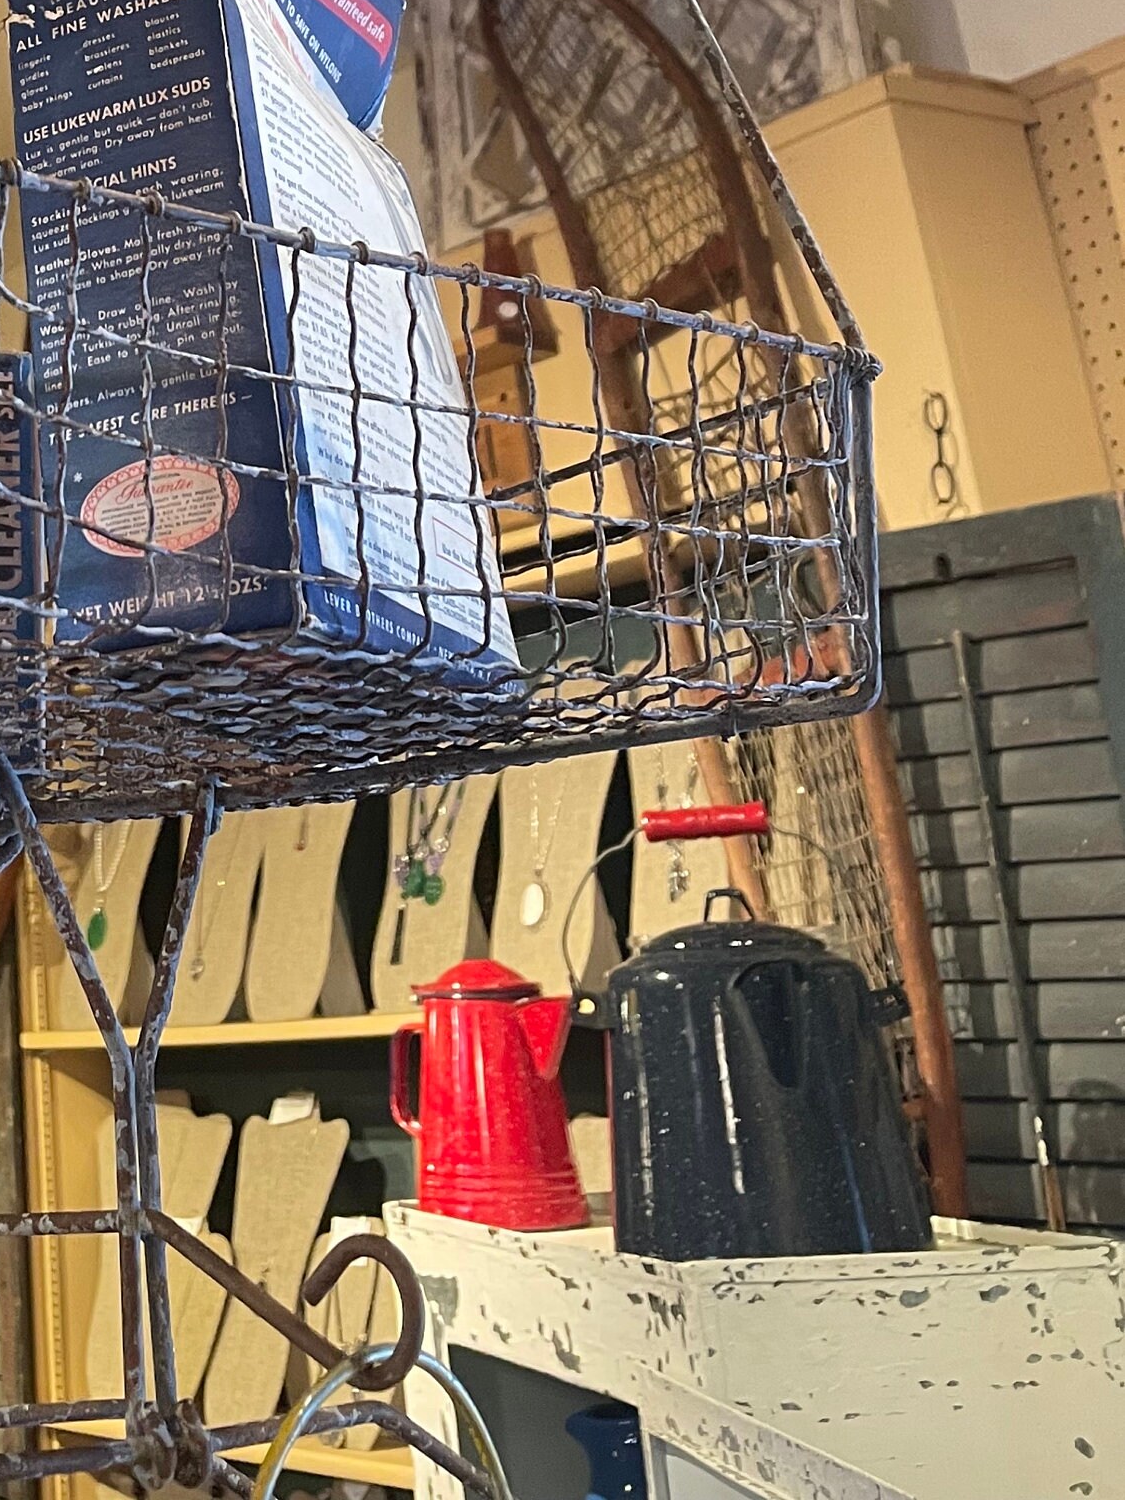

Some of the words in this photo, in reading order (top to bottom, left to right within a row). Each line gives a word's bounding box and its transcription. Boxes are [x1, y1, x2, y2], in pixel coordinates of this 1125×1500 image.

[144, 12, 180, 28] blouses
[367, 14, 386, 43] safe
[16, 34, 43, 53] ALL
[51, 16, 87, 40] FINE
[82, 32, 115, 49] dresses
[146, 26, 181, 42] elastics
[148, 38, 189, 56] blankets
[286, 0, 296, 18] TO
[295, 13, 310, 39] SAVE
[309, 35, 321, 54] ON
[318, 48, 343, 83] NYLONS
[18, 52, 52, 71] lingerie
[84, 42, 130, 62] brassieres
[150, 48, 206, 70] bedspreads
[20, 83, 49, 100] gloves
[87, 73, 124, 90] curtains
[21, 98, 44, 113] baby
[45, 90, 73, 106] things
[23, 125, 49, 144] USE
[51, 98, 136, 136] LUKEWARM
[138, 88, 169, 108] LUX
[171, 76, 212, 98] SUDS
[25, 150, 41, 161] Lux
[46, 145, 54, 154] is
[59, 133, 90, 152] gentle
[93, 127, 111, 140] but
[116, 116, 144, 134] quick
[159, 104, 186, 120] don't
[55, 156, 67, 165] or
[104, 137, 124, 150] Dry
[127, 128, 156, 143] away
[159, 119, 184, 133] from
[80, 158, 103, 170] iron.
[131, 156, 178, 180] HINTS
[171, 165, 224, 187] wearing,
[171, 180, 224, 200] lukewarm
[33, 243, 50, 254] Lux
[79, 245, 121, 262] Gloves.
[157, 226, 184, 241] fresh
[36, 273, 59, 288] final
[91, 258, 123, 272] When
[125, 244, 171, 265] parally
[75, 280, 92, 291] ase
[96, 276, 106, 285] to
[110, 266, 143, 282] shape
[148, 260, 169, 271] Dry
[172, 252, 203, 266] away
[43, 302, 64, 314] eat.
[98, 307, 127, 321] Draw
[134, 295, 175, 311] oline.
[183, 283, 216, 298] Wash
[41, 333, 66, 351] hand
[118, 314, 164, 329] rubbg.
[167, 303, 196, 318] After
[199, 295, 240, 311] rinsg.
[42, 351, 59, 365] roll
[166, 315, 200, 333] Unroll
[87, 354, 112, 367] Ease
[117, 349, 128, 359] to
[177, 333, 195, 347] pin
[201, 329, 215, 339] on
[46, 396, 93, 415] Dipers.
[97, 385, 135, 403] Always
[161, 371, 196, 389] gentle
[200, 366, 219, 378] Lux
[48, 428, 72, 446] TE
[78, 415, 125, 438] FEST
[130, 405, 168, 425] CRE
[174, 394, 217, 415] THERE
[224, 391, 237, 405] IS
[324, 589, 352, 614] LEVER
[355, 603, 394, 635] BOTHERS
[396, 625, 431, 652] COMPA
